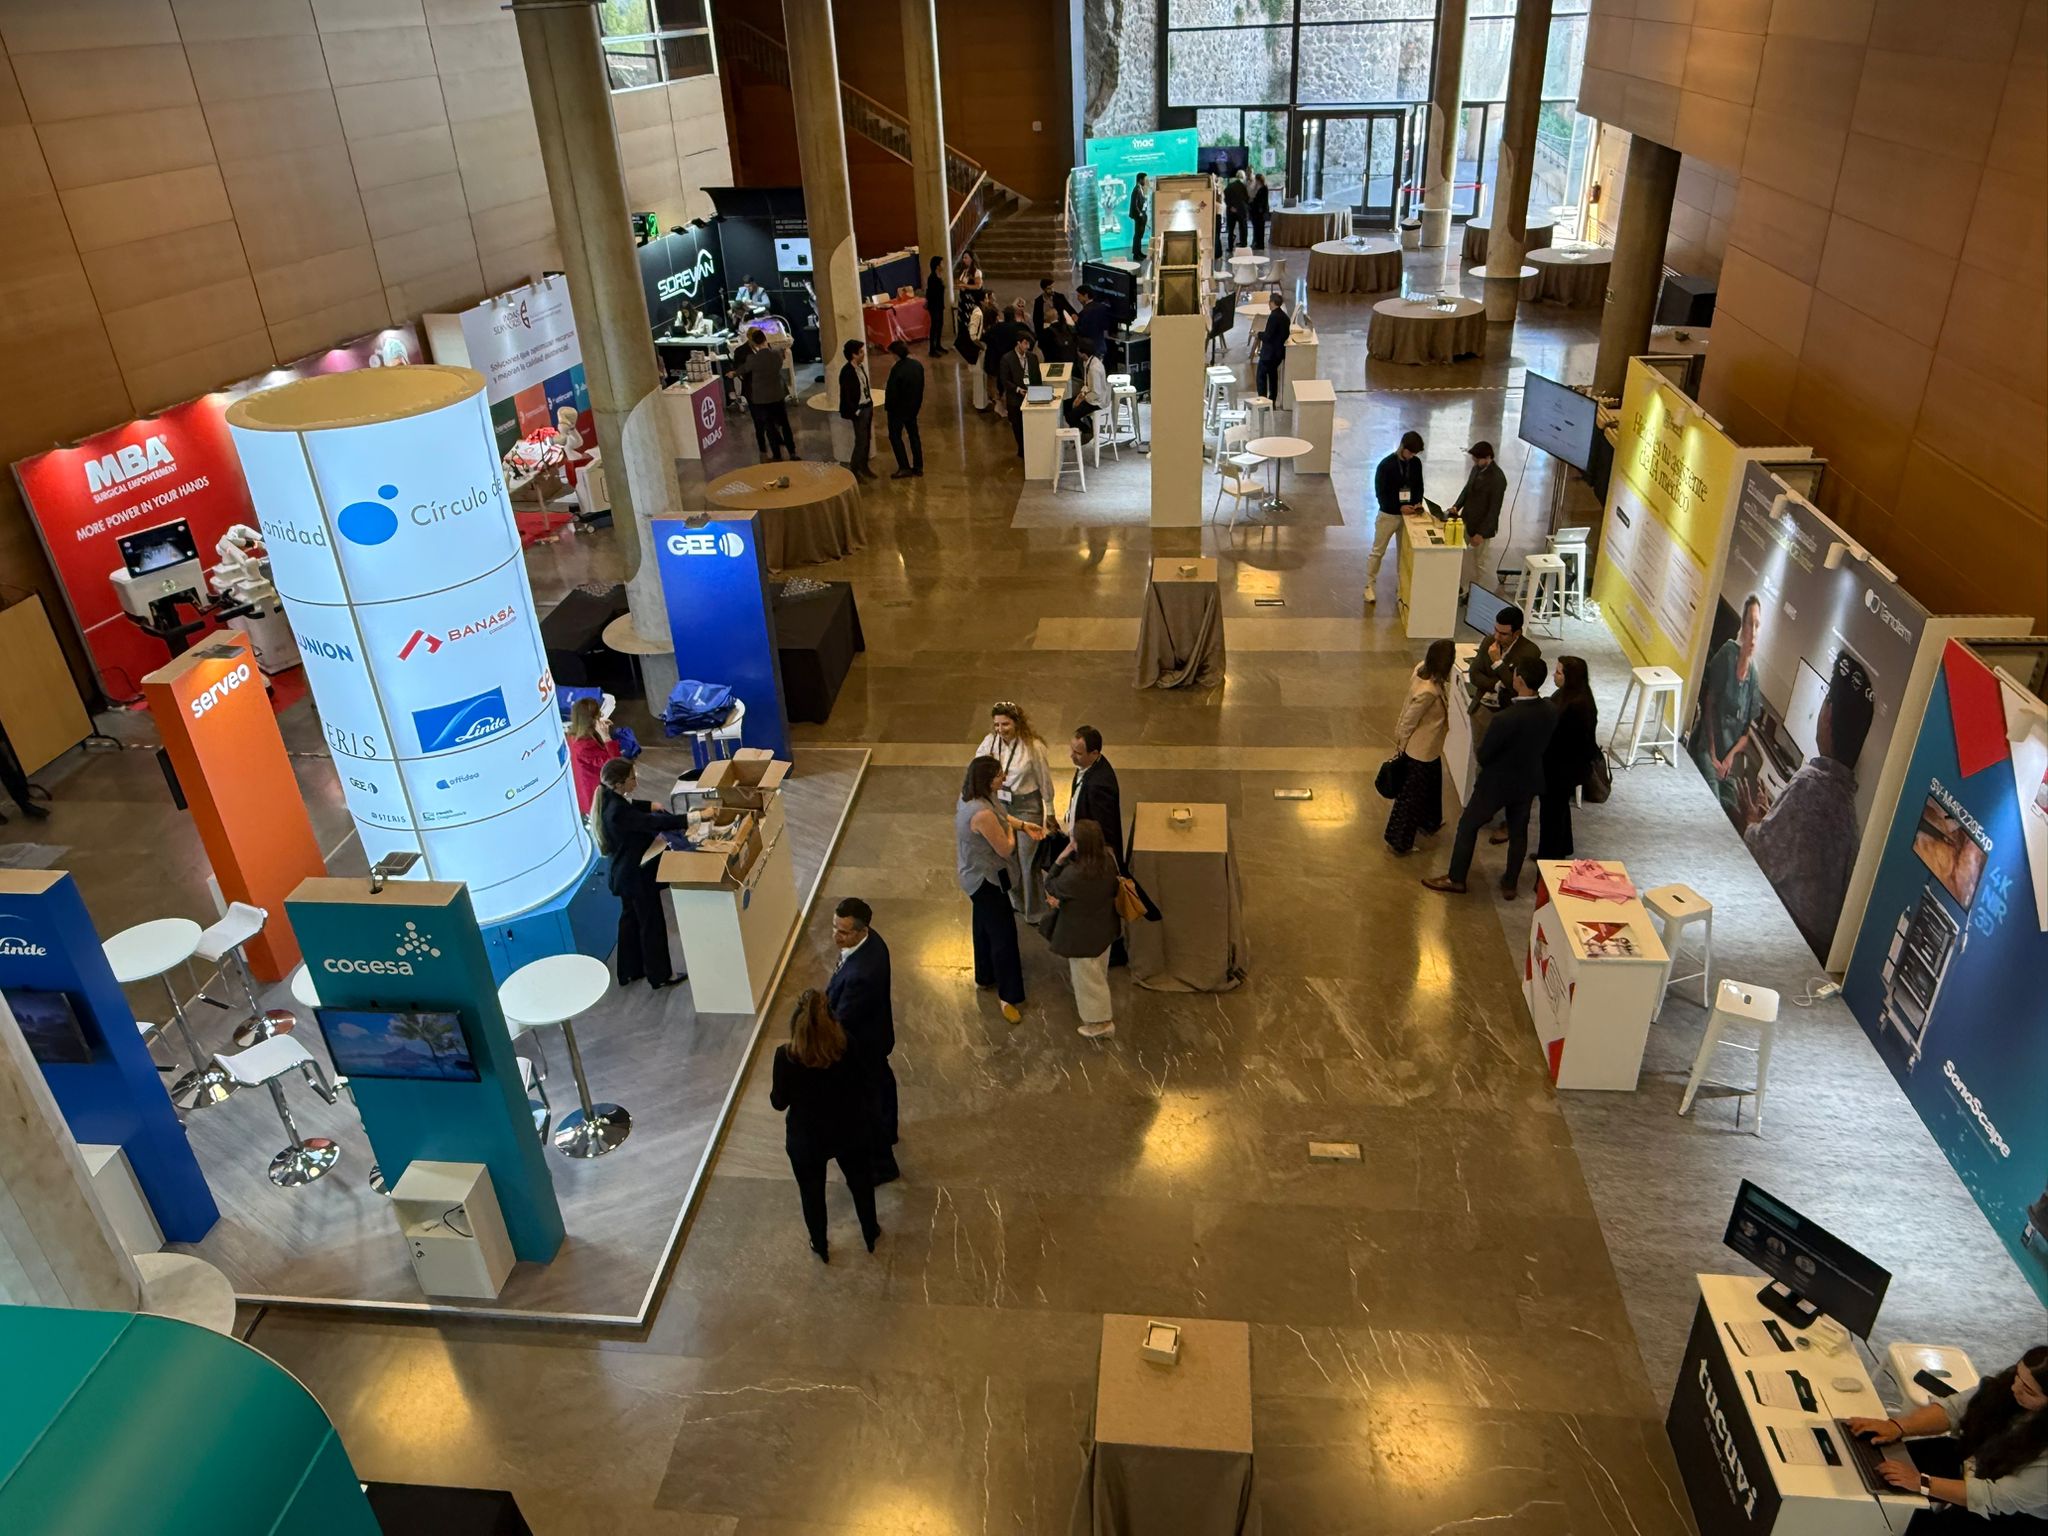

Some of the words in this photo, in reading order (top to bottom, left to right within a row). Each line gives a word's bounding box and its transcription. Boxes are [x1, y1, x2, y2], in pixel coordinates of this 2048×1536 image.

[657, 250, 715, 301] SOREVAN
[702, 427, 723, 450] INDAS
[84, 435, 175, 493] MBA
[92, 483, 129, 504] SURGICAL
[127, 462, 178, 491] EMPOWERMENT
[76, 519, 106, 542] MORE
[105, 505, 141, 529] POWER
[140, 500, 153, 514] IN
[153, 489, 179, 508] YOUR
[178, 475, 210, 498] HANDS
[411, 487, 488, 526] Círculo
[667, 534, 718, 556] GEE
[448, 605, 516, 642] BANASA
[191, 663, 250, 719] serveo
[455, 716, 508, 743] Linde
[1943, 1060, 2011, 1158] SonoScape
